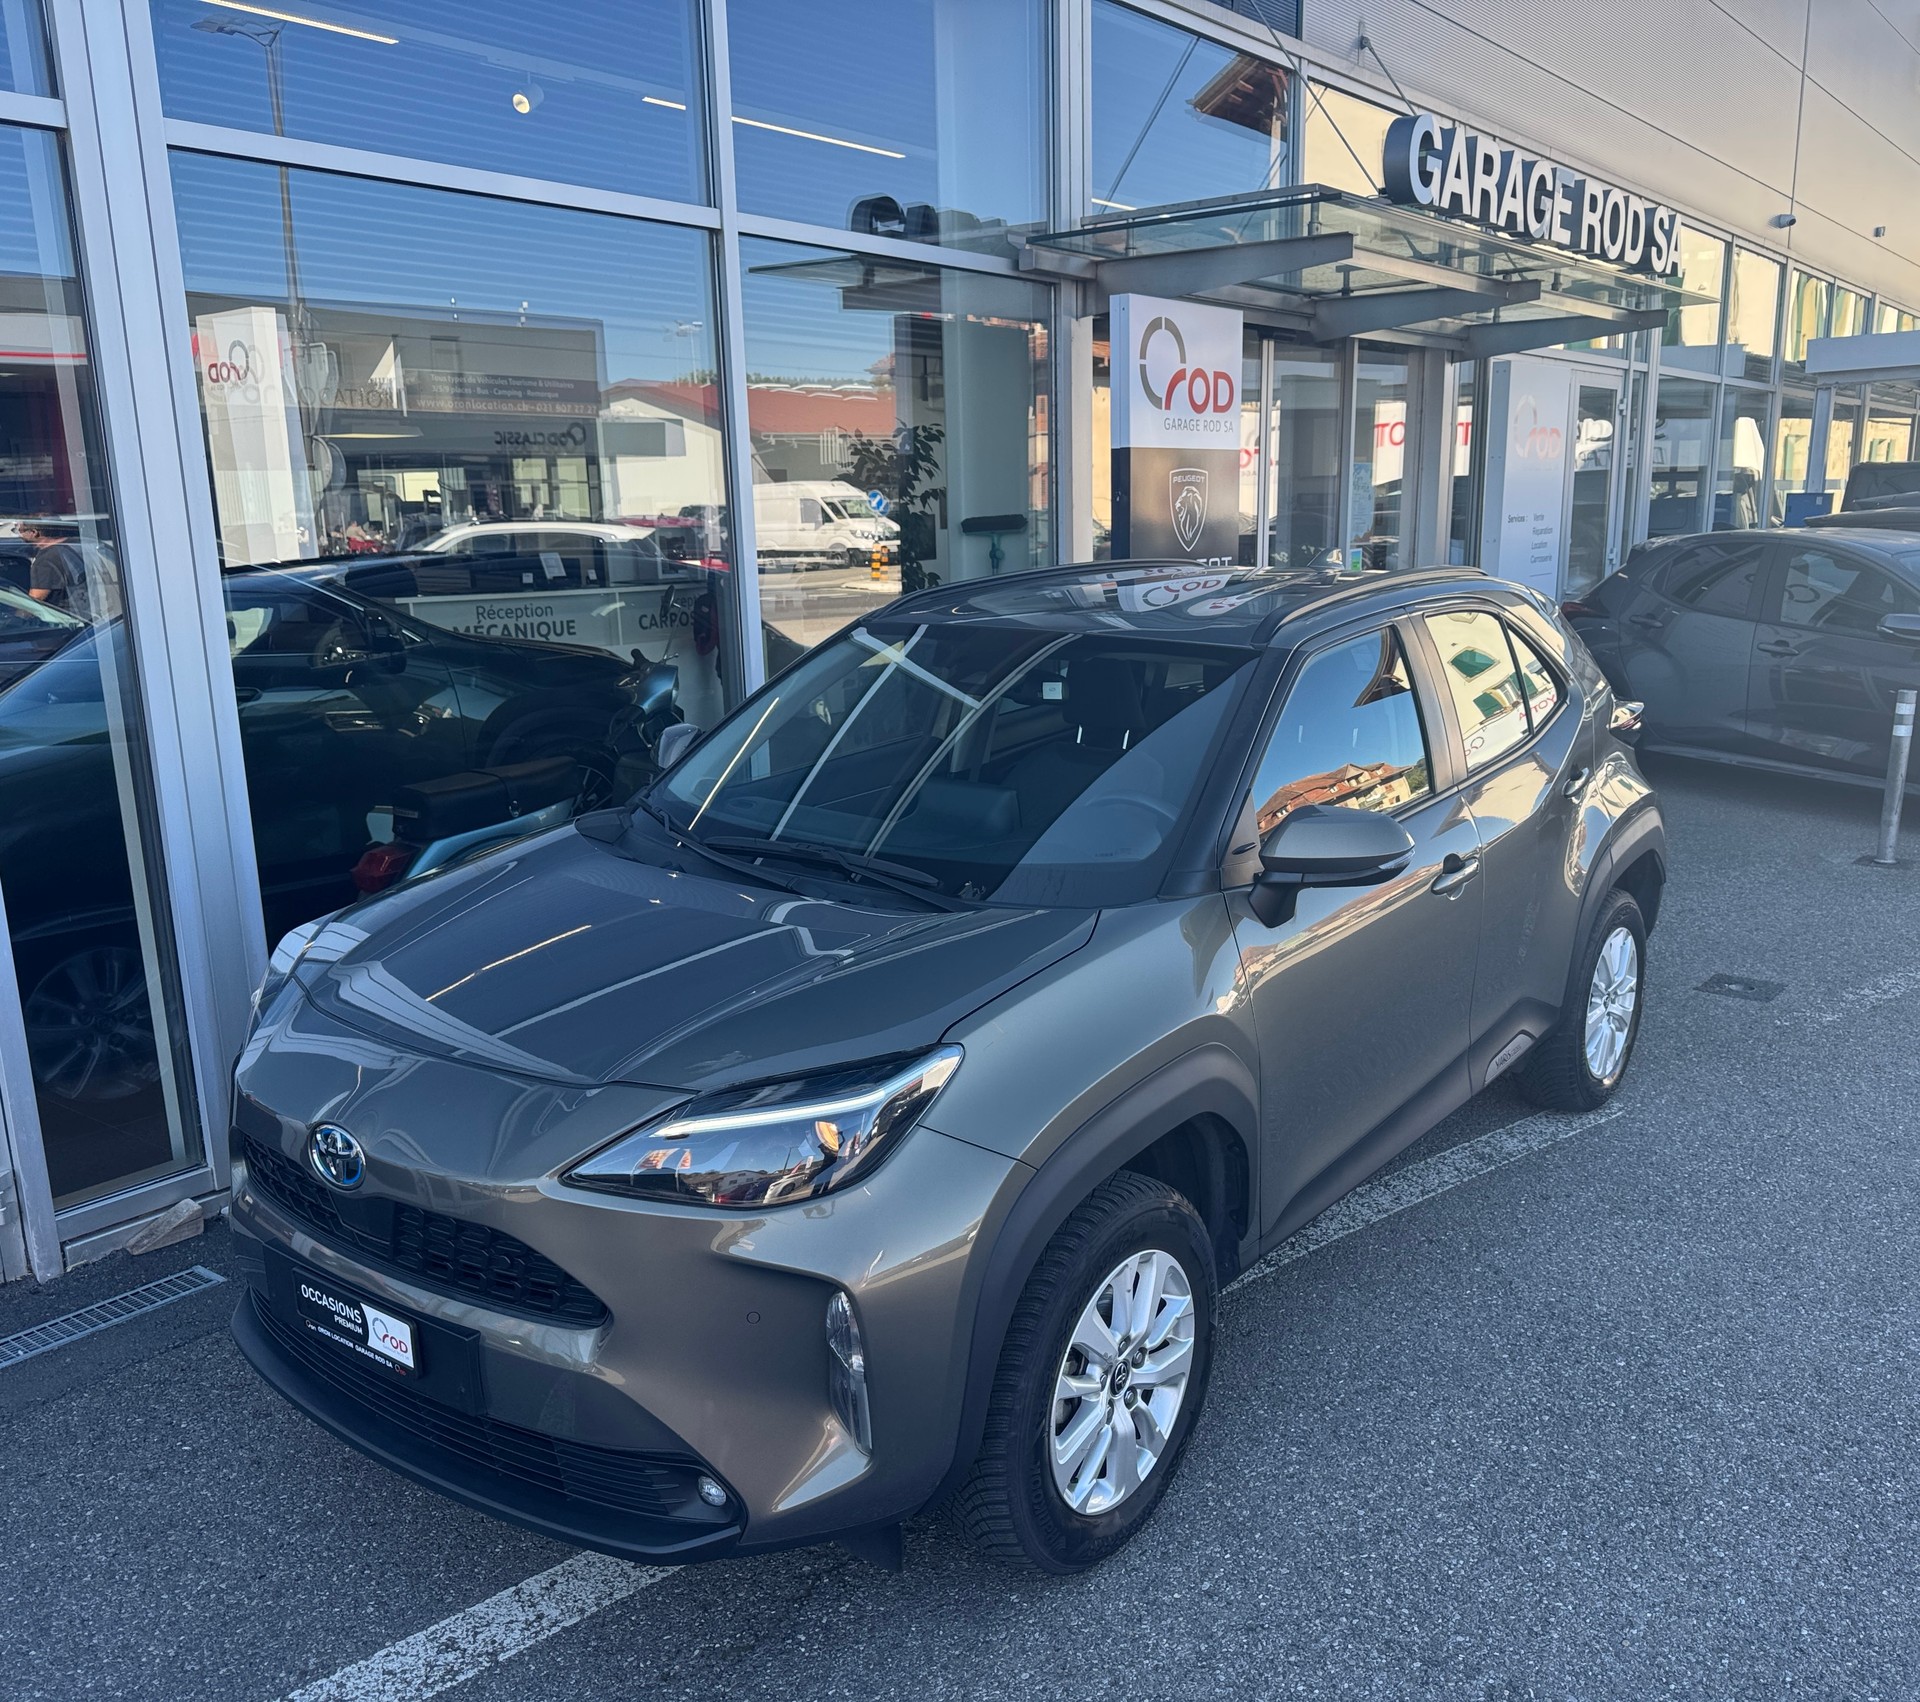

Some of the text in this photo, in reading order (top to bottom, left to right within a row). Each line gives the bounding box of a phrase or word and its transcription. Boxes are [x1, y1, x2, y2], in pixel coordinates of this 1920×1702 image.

[1408, 113, 1683, 278] GARAGE ROD SA
[1163, 417, 1234, 433] GARAGE ROD SA
[1172, 474, 1206, 484] PEUGEOT
[475, 603, 554, 621] Réception
[301, 1284, 362, 1323] OCCASIONS
[334, 1315, 363, 1335] PREMIUM
